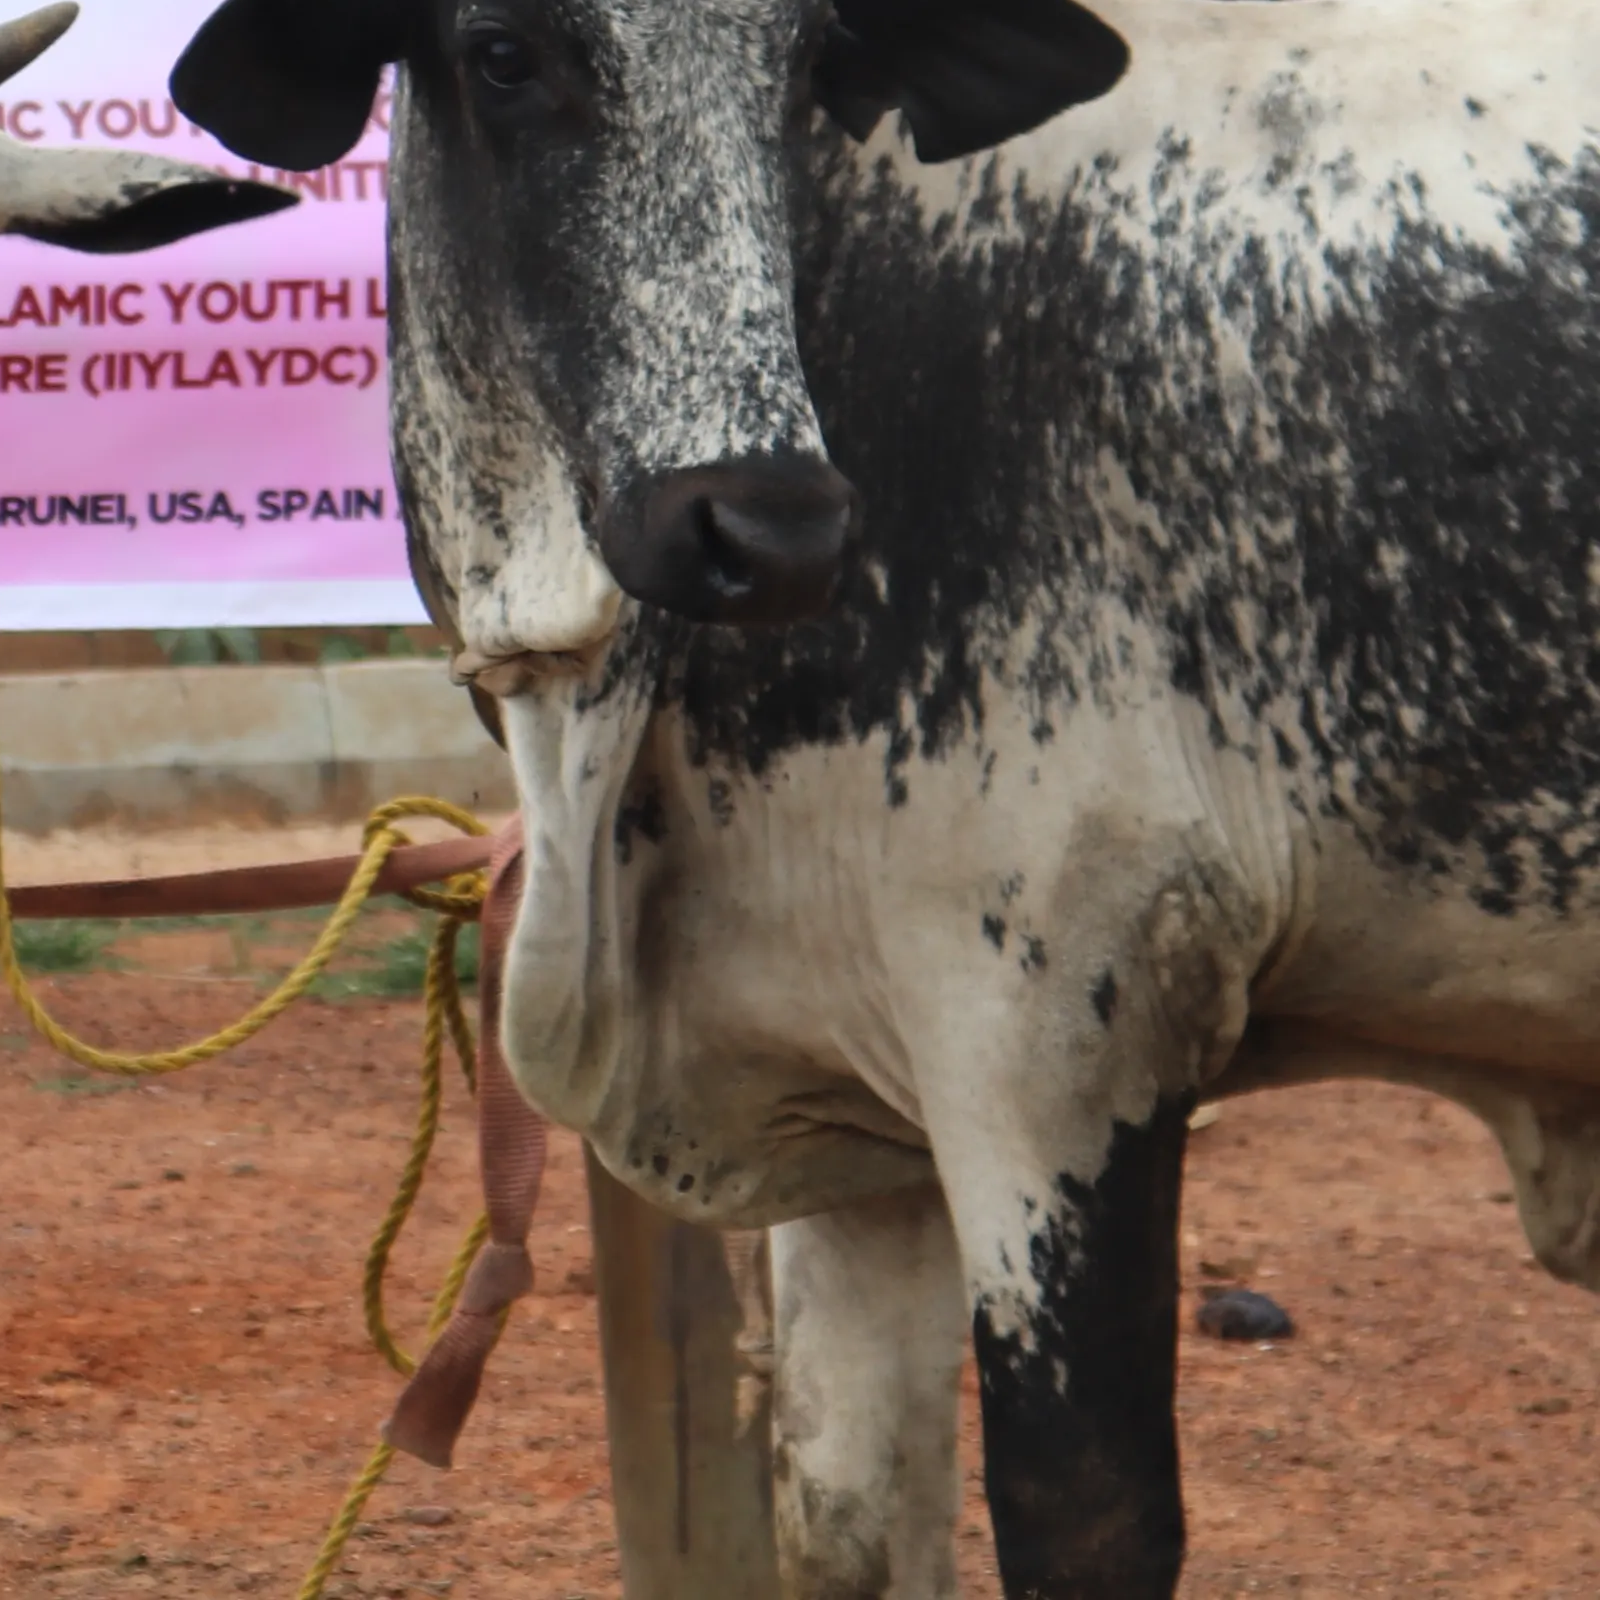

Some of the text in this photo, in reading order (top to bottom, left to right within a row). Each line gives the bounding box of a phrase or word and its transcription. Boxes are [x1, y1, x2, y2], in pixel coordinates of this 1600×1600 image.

[160, 277, 351, 326] YOUTH
[81, 345, 377, 400] (IIYLAYDC)
[146, 490, 247, 530] USA,
[256, 487, 385, 524] SPAIN
